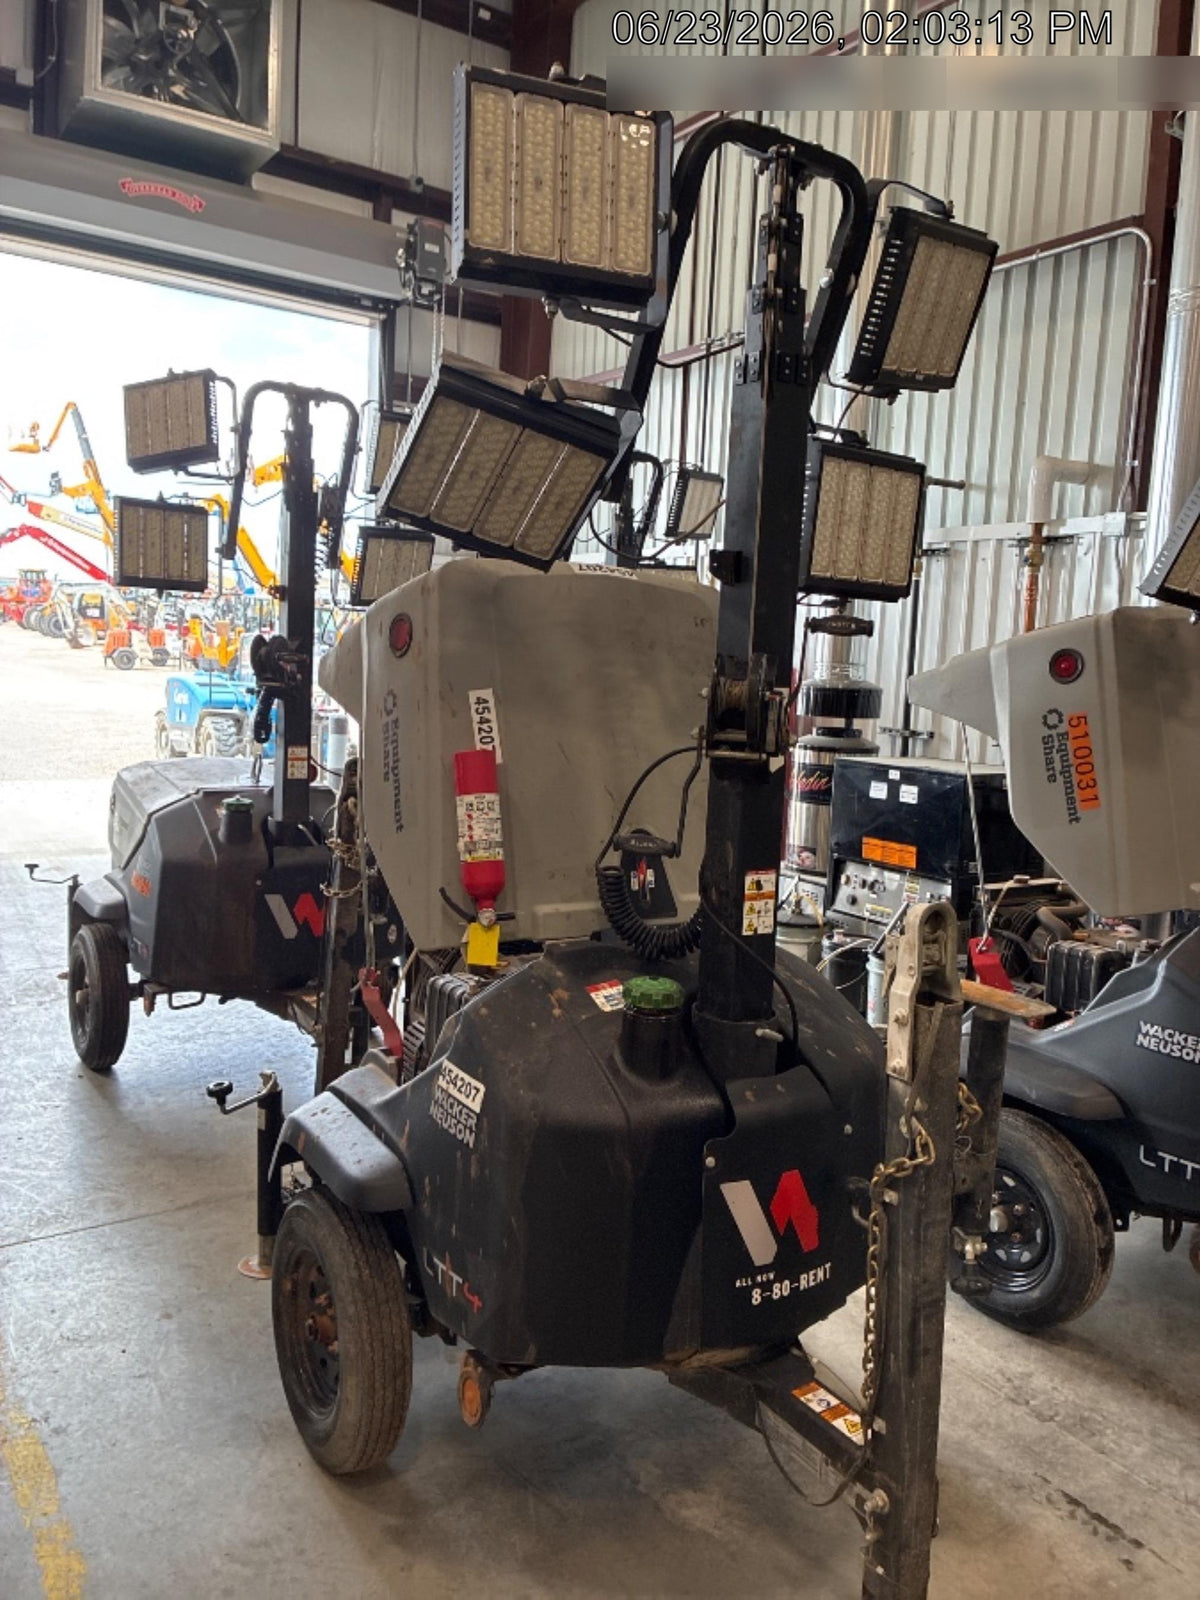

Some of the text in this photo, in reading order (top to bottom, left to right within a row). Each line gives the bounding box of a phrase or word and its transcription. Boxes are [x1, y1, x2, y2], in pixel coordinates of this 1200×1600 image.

[390, 717, 405, 834] Equipment
[1042, 734, 1058, 785] Share
[1056, 731, 1082, 825] Equipment
[1068, 715, 1099, 804] 510031
[435, 1085, 477, 1131] WACKER
[438, 1065, 481, 1103] 454207
[429, 1100, 476, 1149] NEUSON
[751, 1262, 832, 1306] 8-80-RENT
